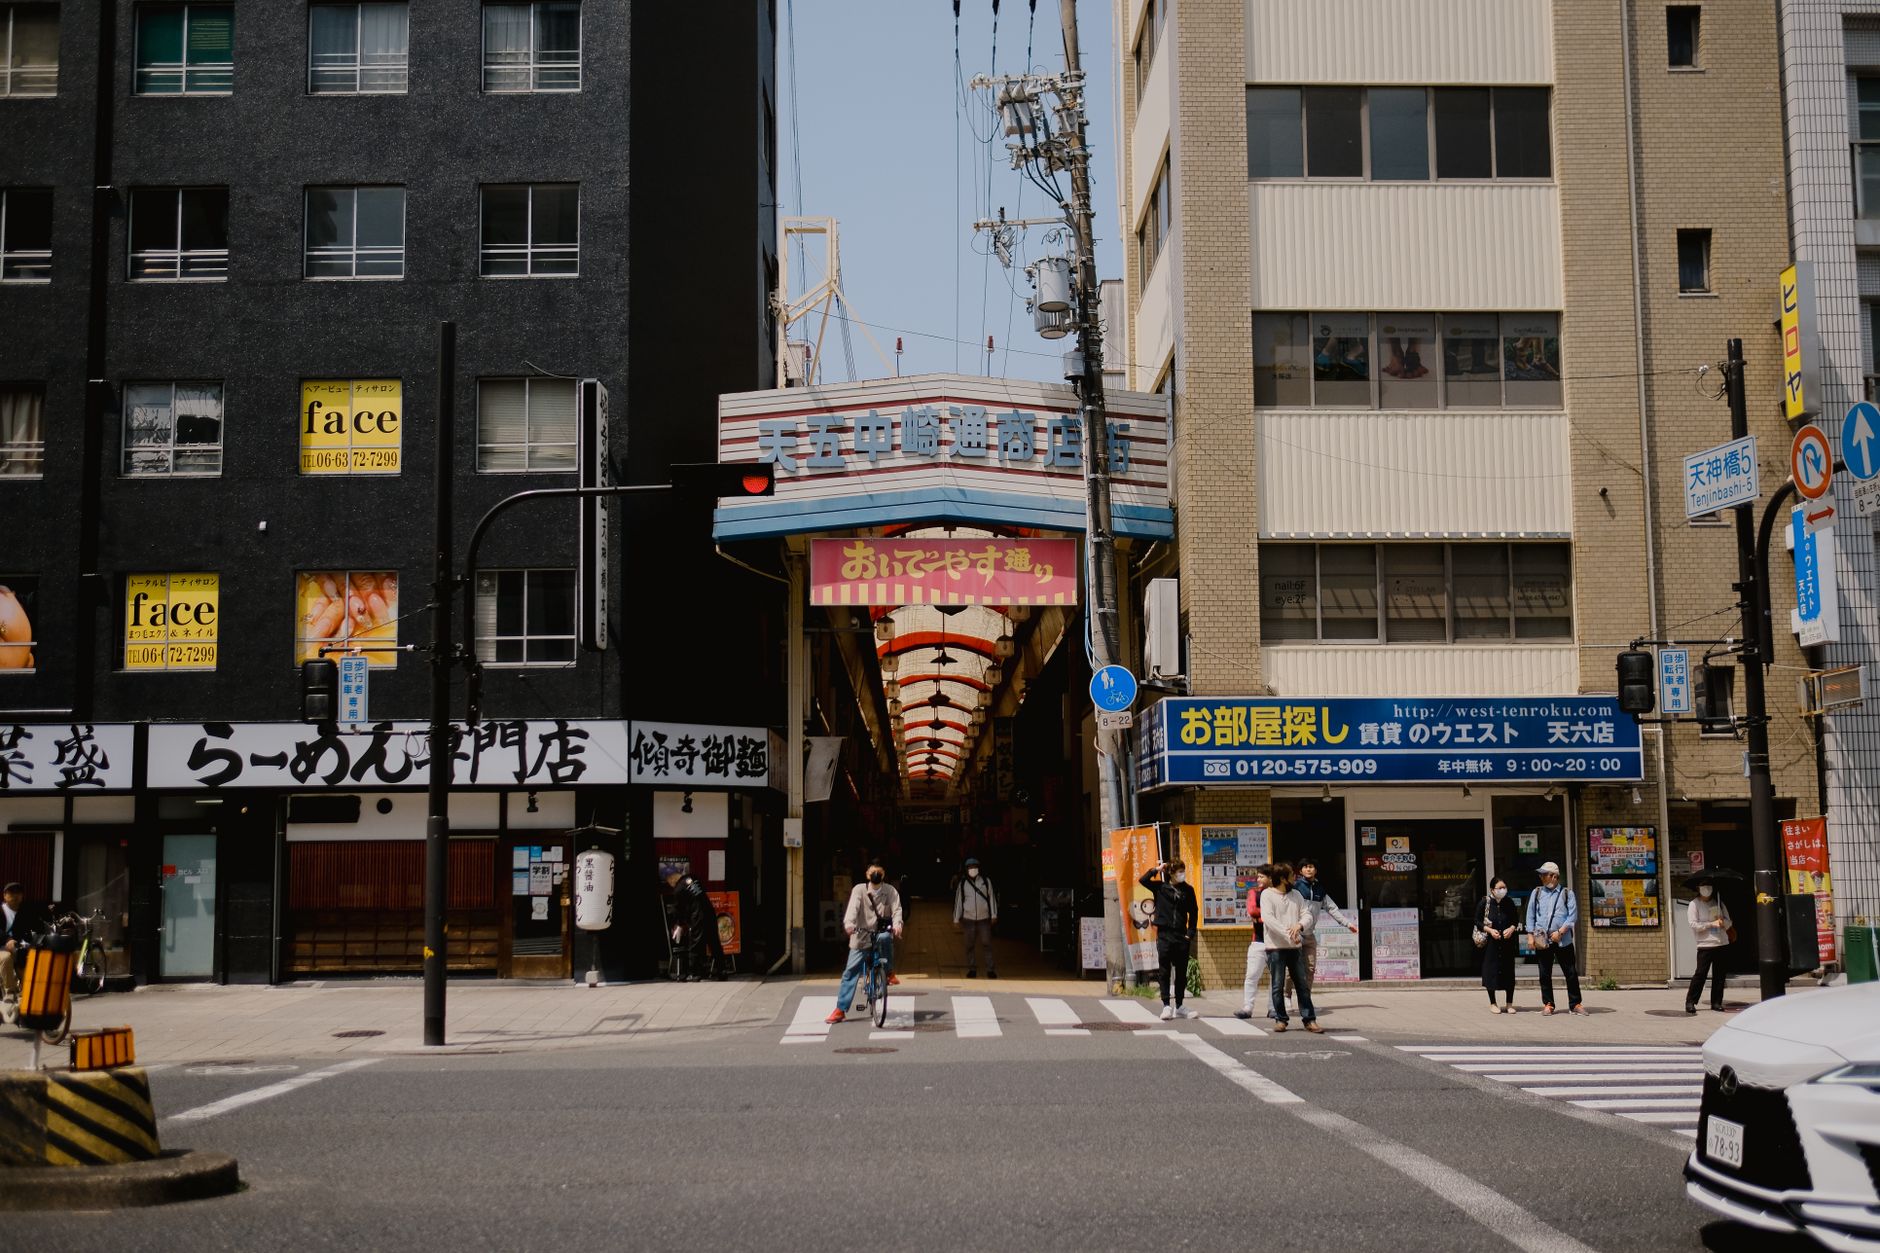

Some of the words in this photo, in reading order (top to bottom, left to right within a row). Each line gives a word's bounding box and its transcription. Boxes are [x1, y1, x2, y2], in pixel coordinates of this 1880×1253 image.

[1783, 284, 1802, 402] ヒロヤ
[304, 400, 398, 434] face
[1690, 445, 1752, 491] 天神橋5
[1691, 476, 1753, 508] Tenjinbashi-5
[131, 578, 217, 588] トータルビーティサロン
[130, 592, 216, 626] face
[1102, 715, 1130, 727] 8-22
[1393, 704, 1613, 720] http://west-tenroku.com
[1180, 706, 1349, 746] お部屋探し
[1547, 721, 1615, 744] 天六店
[1236, 759, 1378, 776] 0120-575-909
[1438, 759, 1494, 774] 年中無休
[1784, 825, 1811, 836] 住まい
